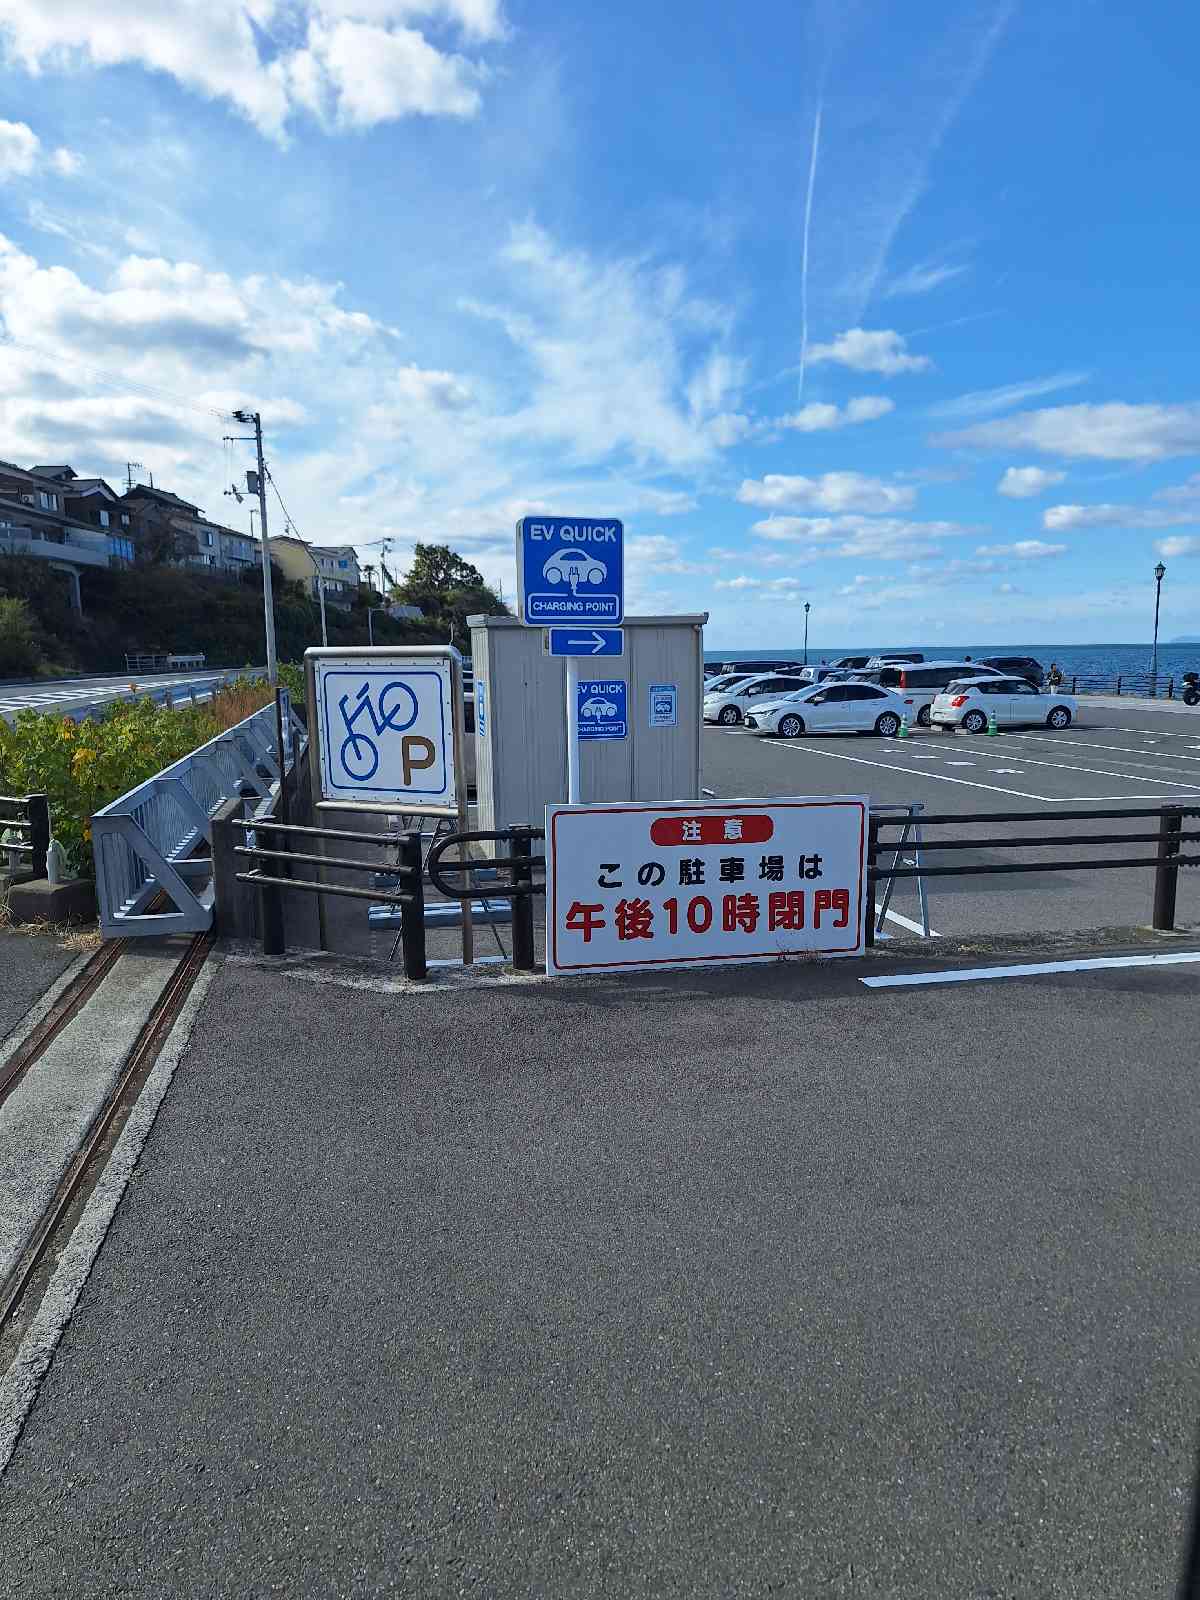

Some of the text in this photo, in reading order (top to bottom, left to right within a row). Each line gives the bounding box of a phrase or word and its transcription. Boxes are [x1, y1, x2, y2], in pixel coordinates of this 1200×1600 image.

[530, 525, 616, 543] EV QUICK
[532, 601, 614, 612] CHARGING POINT
[591, 685, 622, 694] QUICK
[401, 735, 436, 786] P
[597, 854, 823, 888] この駐車場は
[565, 888, 850, 942] 午後10時閉門
